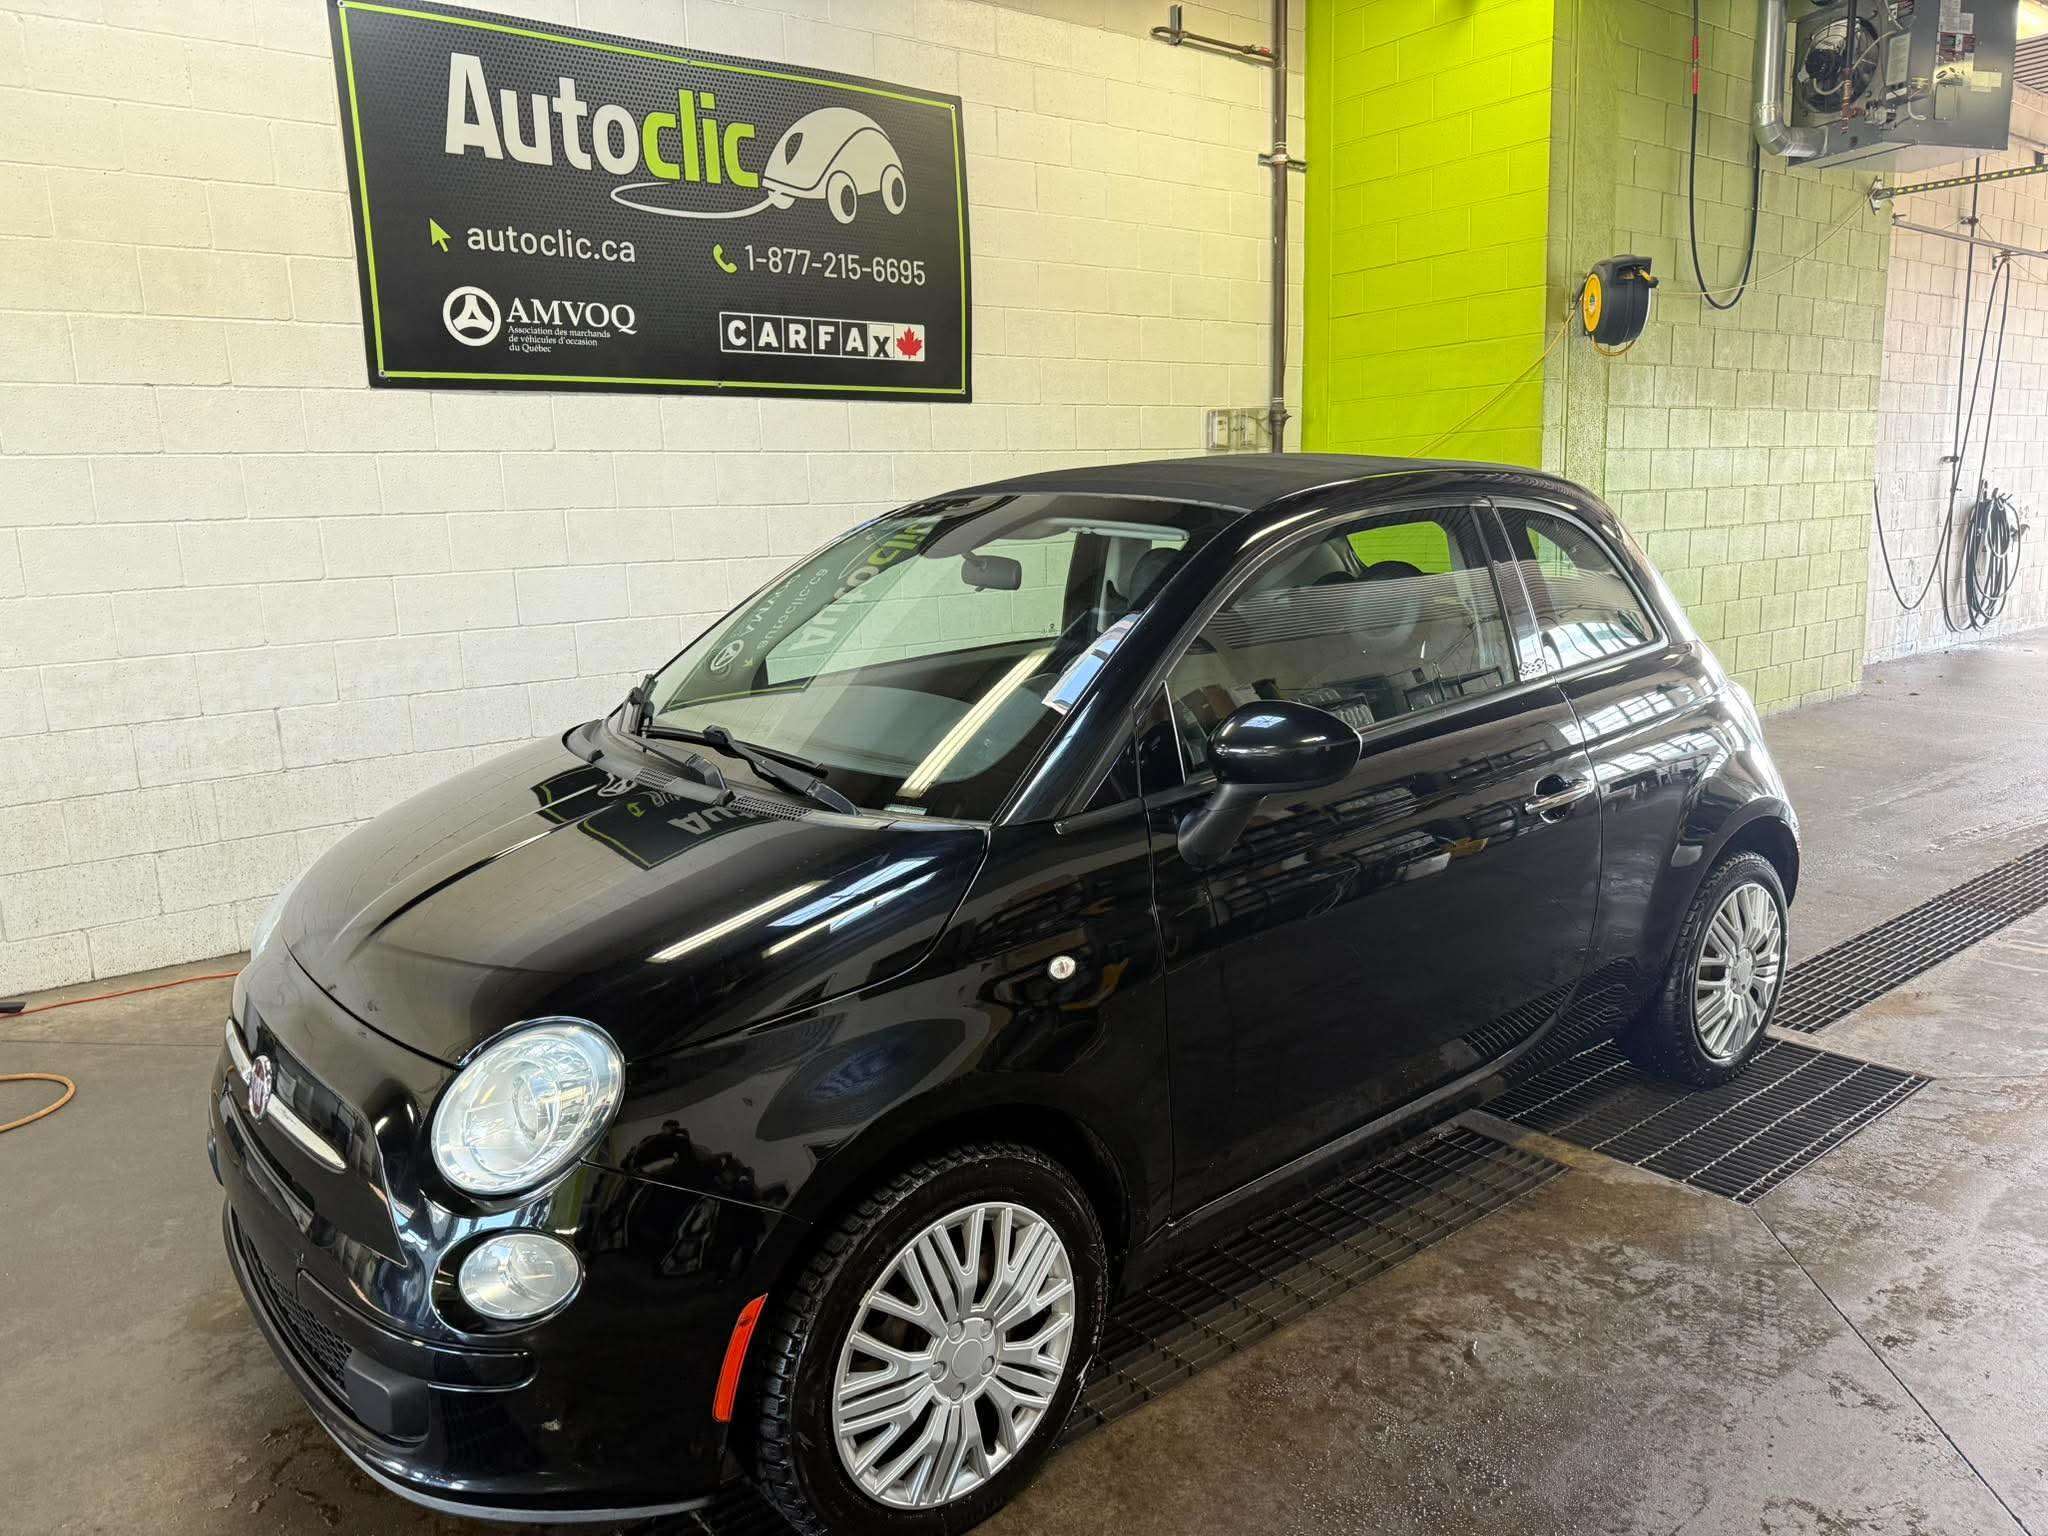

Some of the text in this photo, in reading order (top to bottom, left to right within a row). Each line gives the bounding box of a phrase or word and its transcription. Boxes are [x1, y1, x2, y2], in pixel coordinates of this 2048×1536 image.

[445, 52, 759, 188] Autoclic
[466, 226, 636, 263] autoclic.ca
[744, 245, 926, 286] 1-877-215-6695
[506, 298, 637, 335] AMVOQ
[508, 326, 611, 338] Association des marchands
[508, 335, 598, 346] de véhicules d'occasion
[521, 344, 552, 353] Québec
[727, 319, 891, 358] CARFAX
